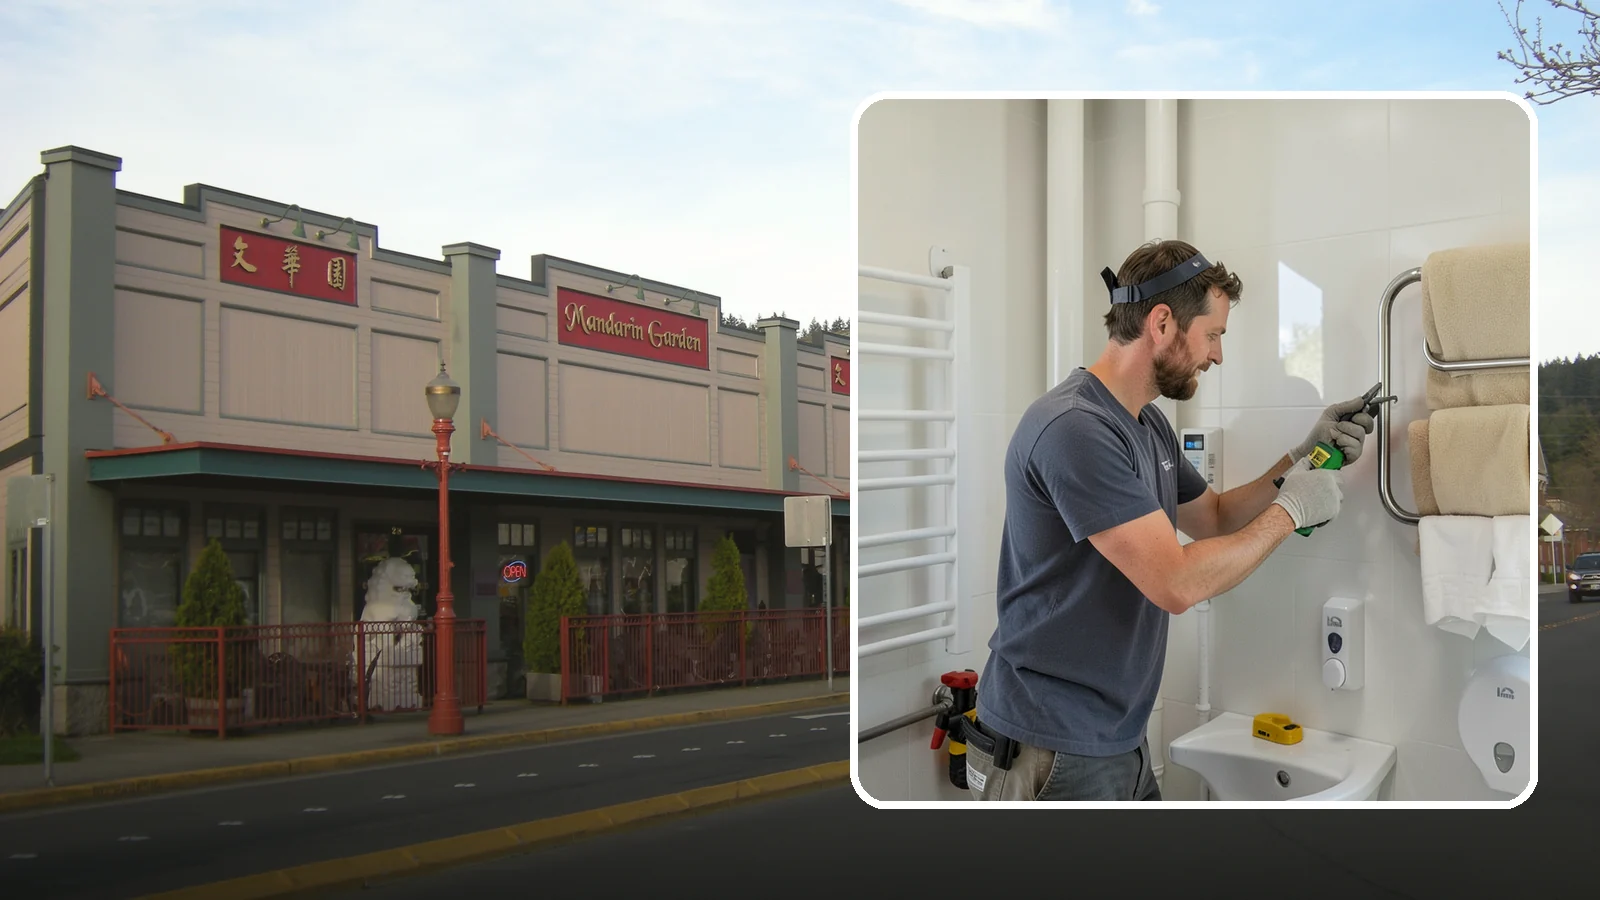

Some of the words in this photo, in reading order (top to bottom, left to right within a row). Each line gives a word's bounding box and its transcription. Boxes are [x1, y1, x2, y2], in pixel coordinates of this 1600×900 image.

[231, 236, 346, 290] 文華園
[564, 302, 644, 341] Mandarin
[648, 320, 701, 352] Garden
[503, 565, 527, 578] OPEN
